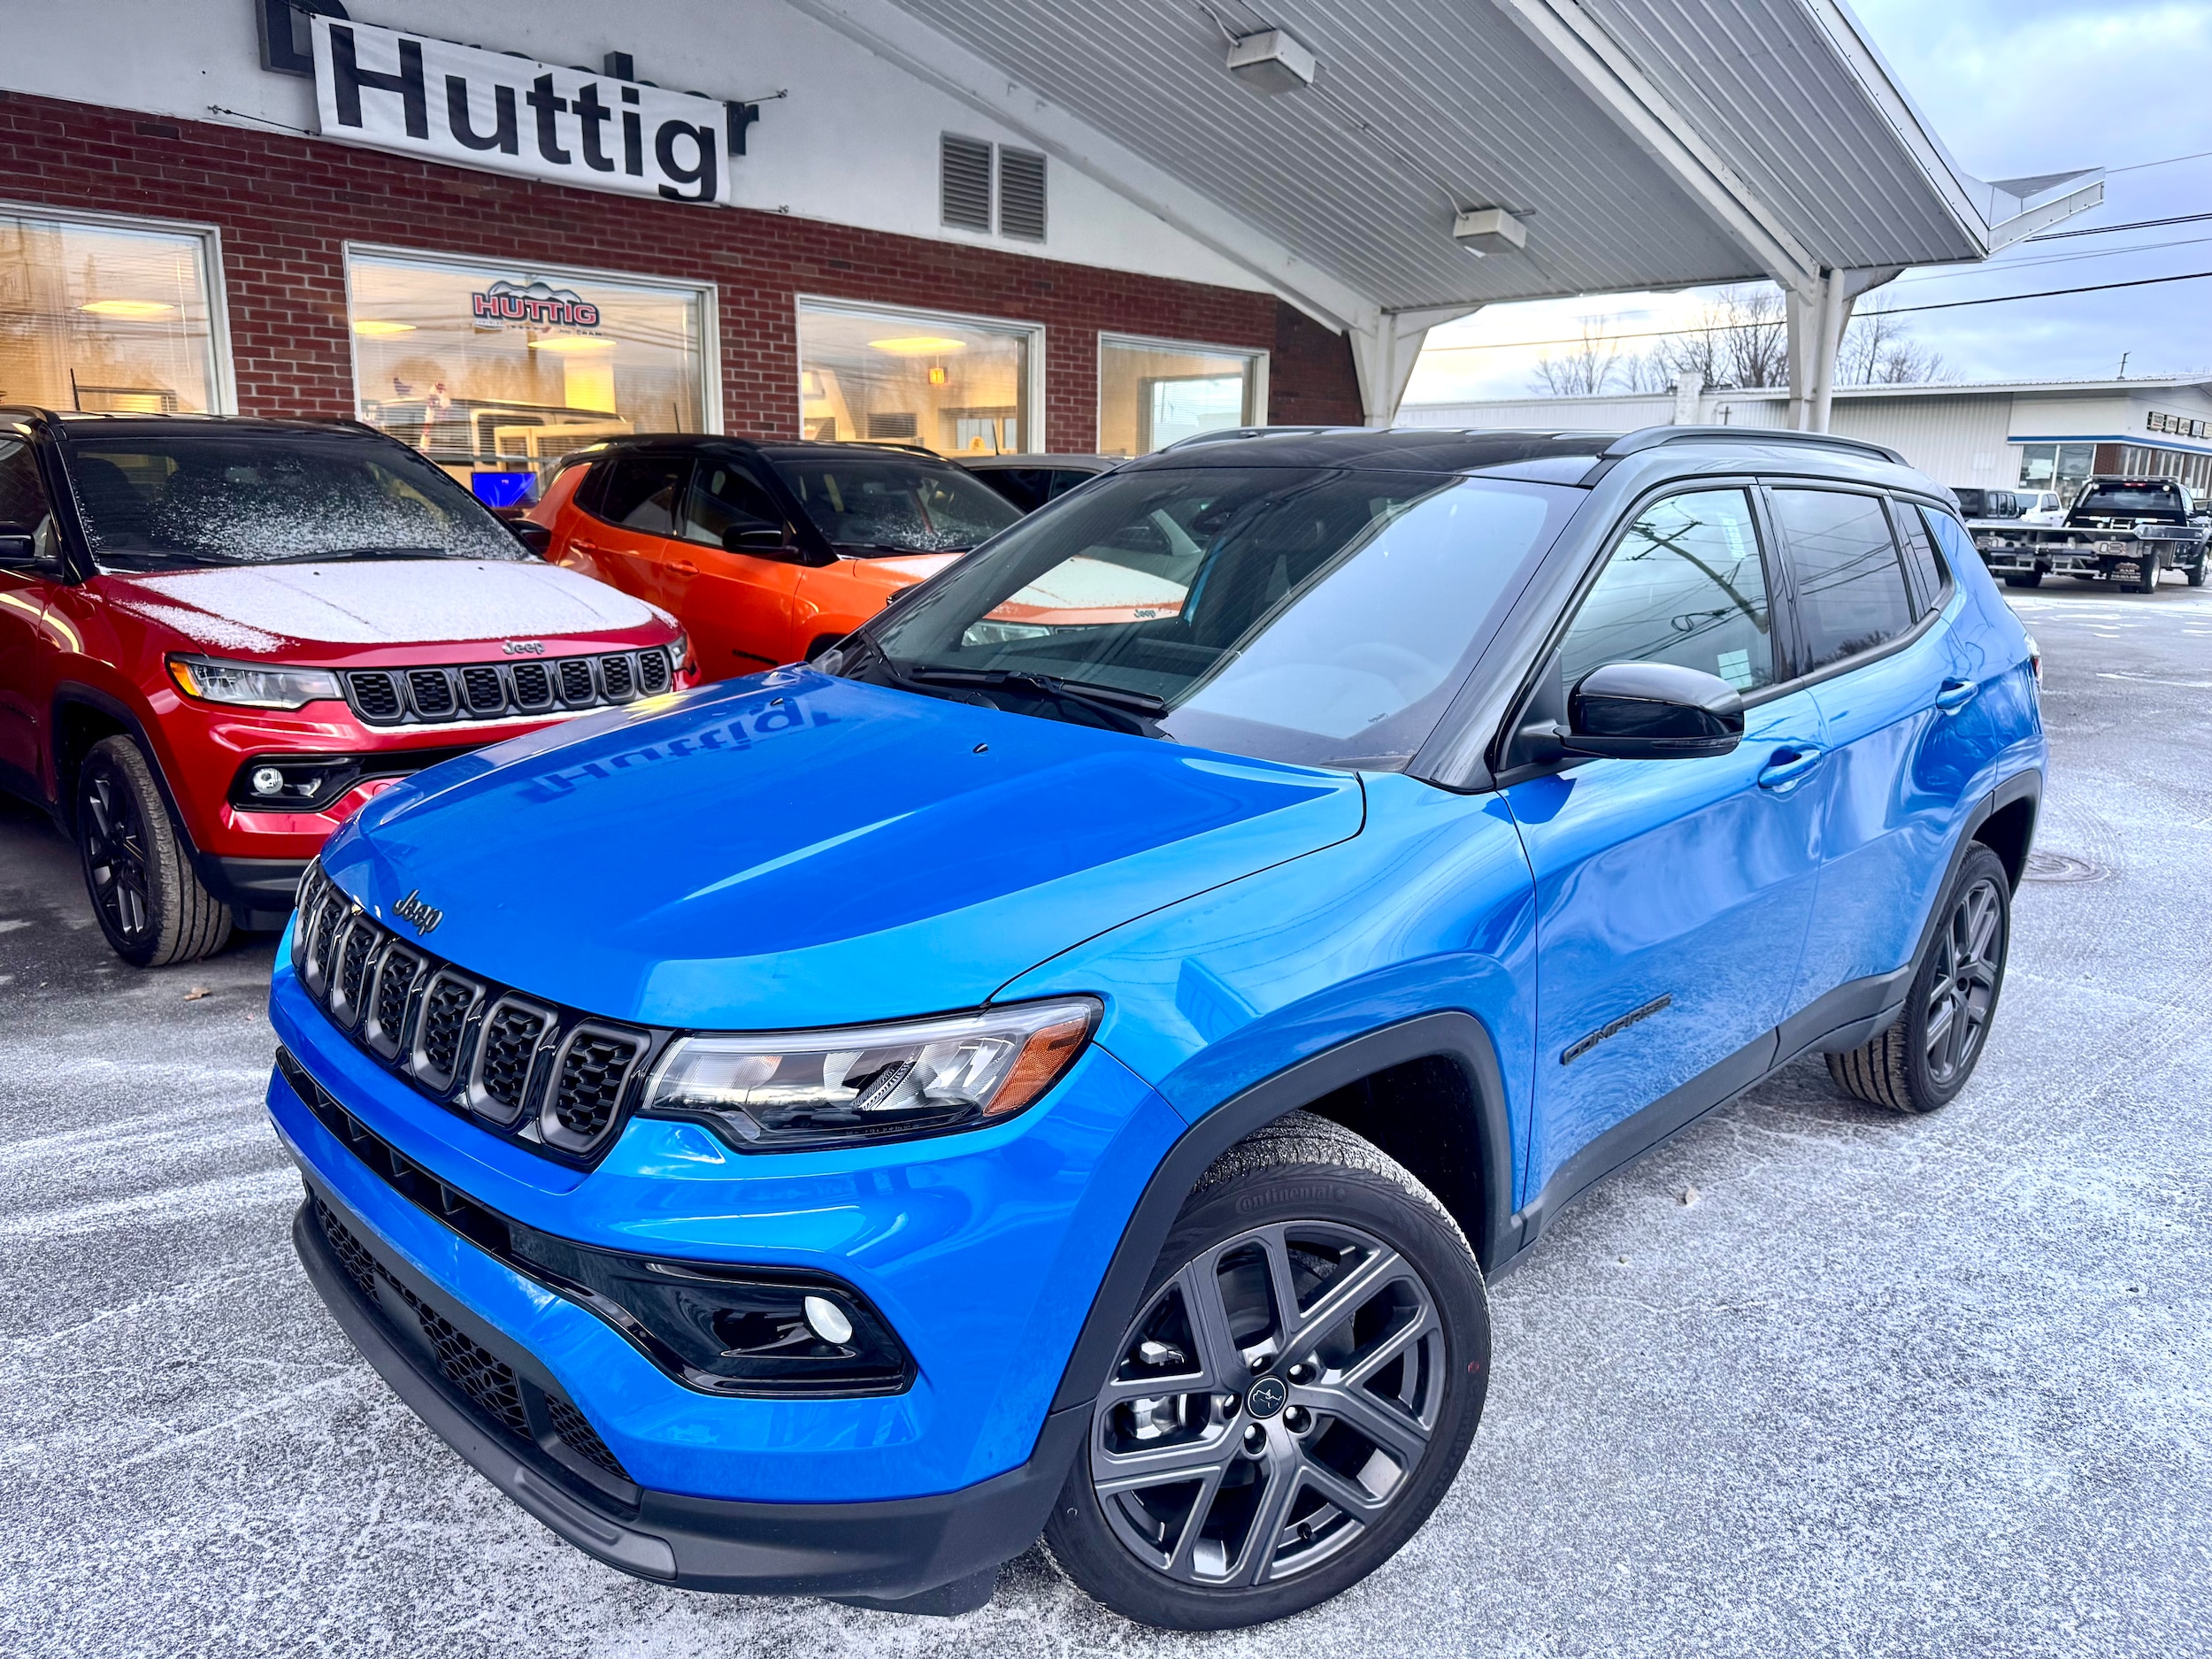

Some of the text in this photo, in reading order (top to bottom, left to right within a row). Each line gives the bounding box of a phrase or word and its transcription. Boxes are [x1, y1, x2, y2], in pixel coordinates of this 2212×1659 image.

[329, 23, 718, 203] Huttig
[473, 294, 599, 326] HUTTIG
[1133, 609, 1156, 618] Jeep
[502, 640, 545, 656] Jeep
[393, 888, 443, 936] Jeep
[1559, 991, 1671, 1065] COMPASS
